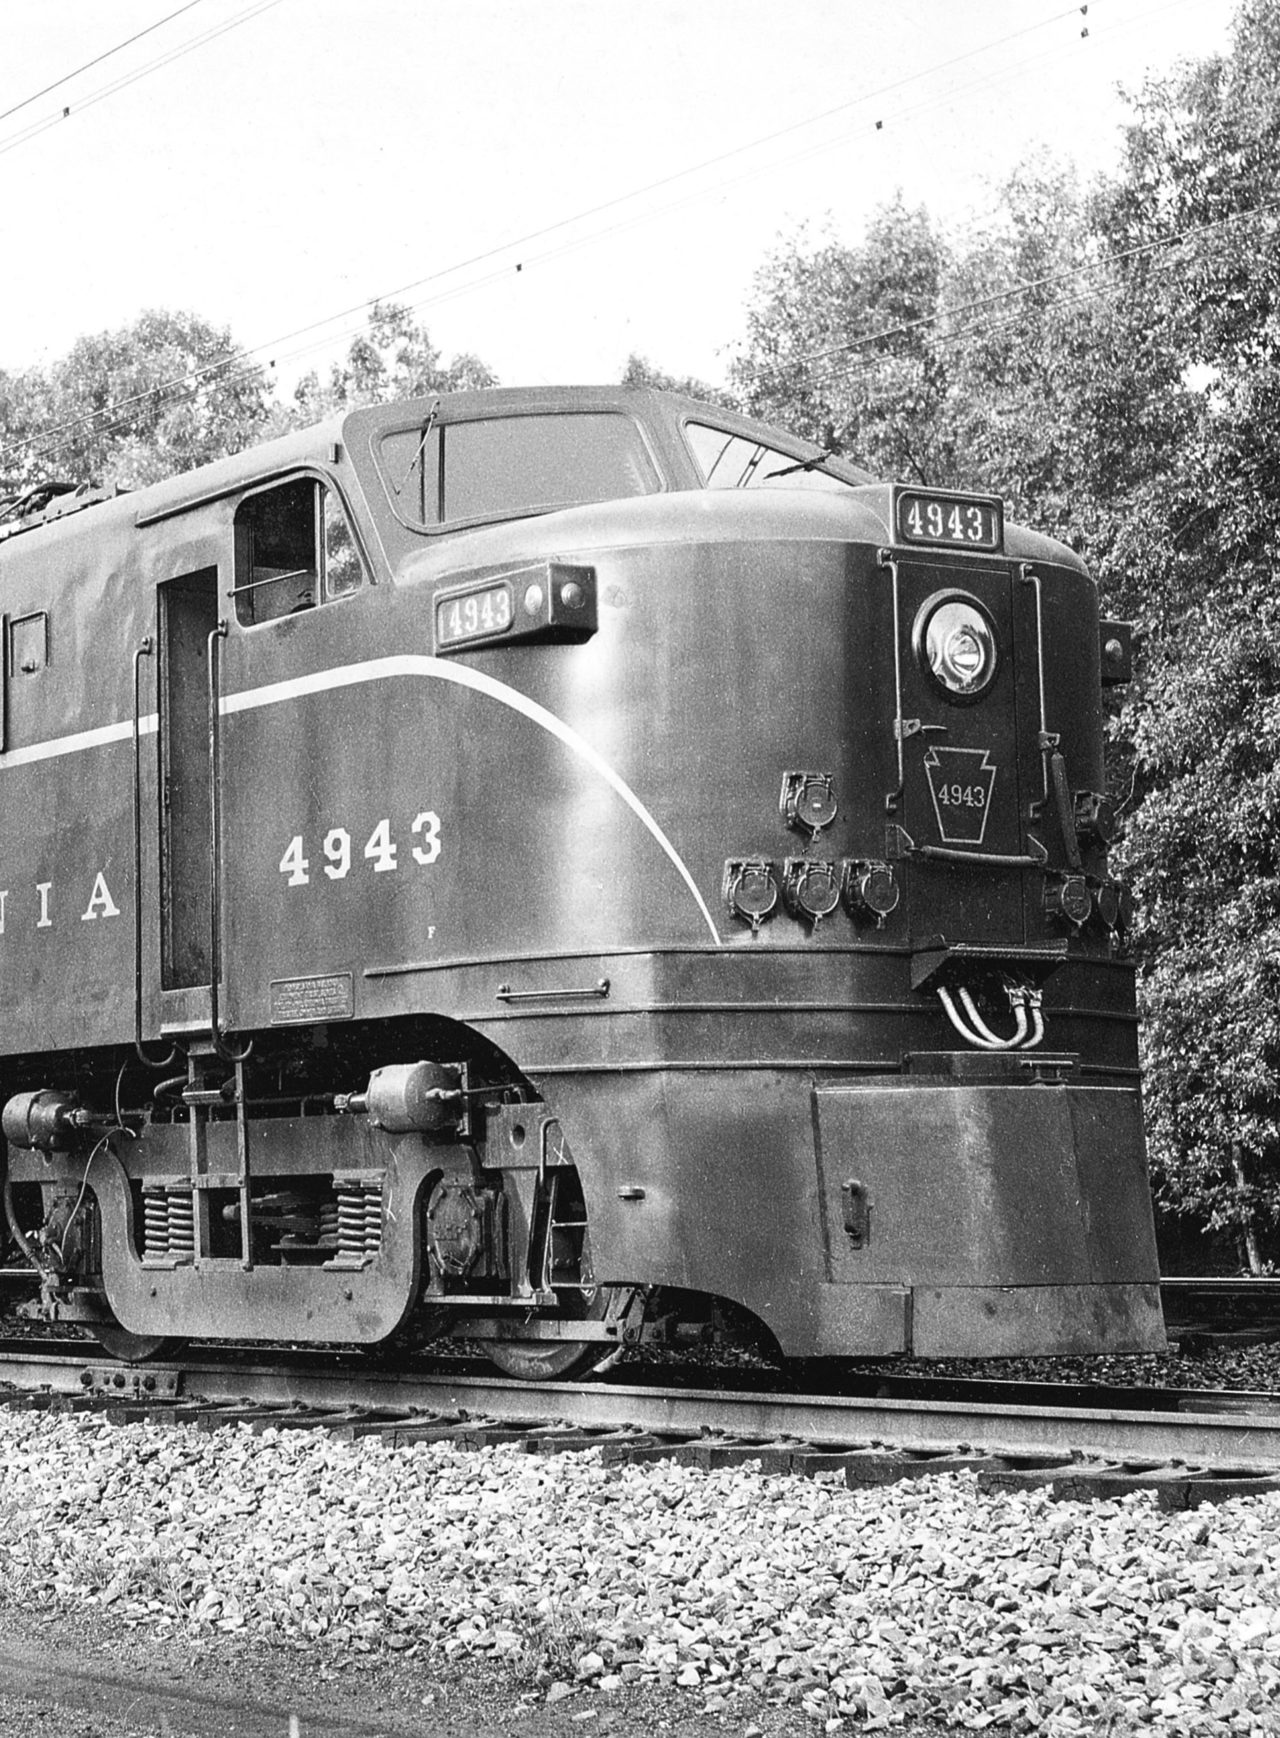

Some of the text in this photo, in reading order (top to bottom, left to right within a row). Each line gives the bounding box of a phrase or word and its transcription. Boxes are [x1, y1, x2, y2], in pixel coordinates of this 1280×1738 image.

[907, 501, 984, 541] 4943
[449, 589, 510, 636] 4943
[938, 783, 985, 807] 4943
[279, 810, 442, 887] 4943
[427, 925, 436, 939] F
